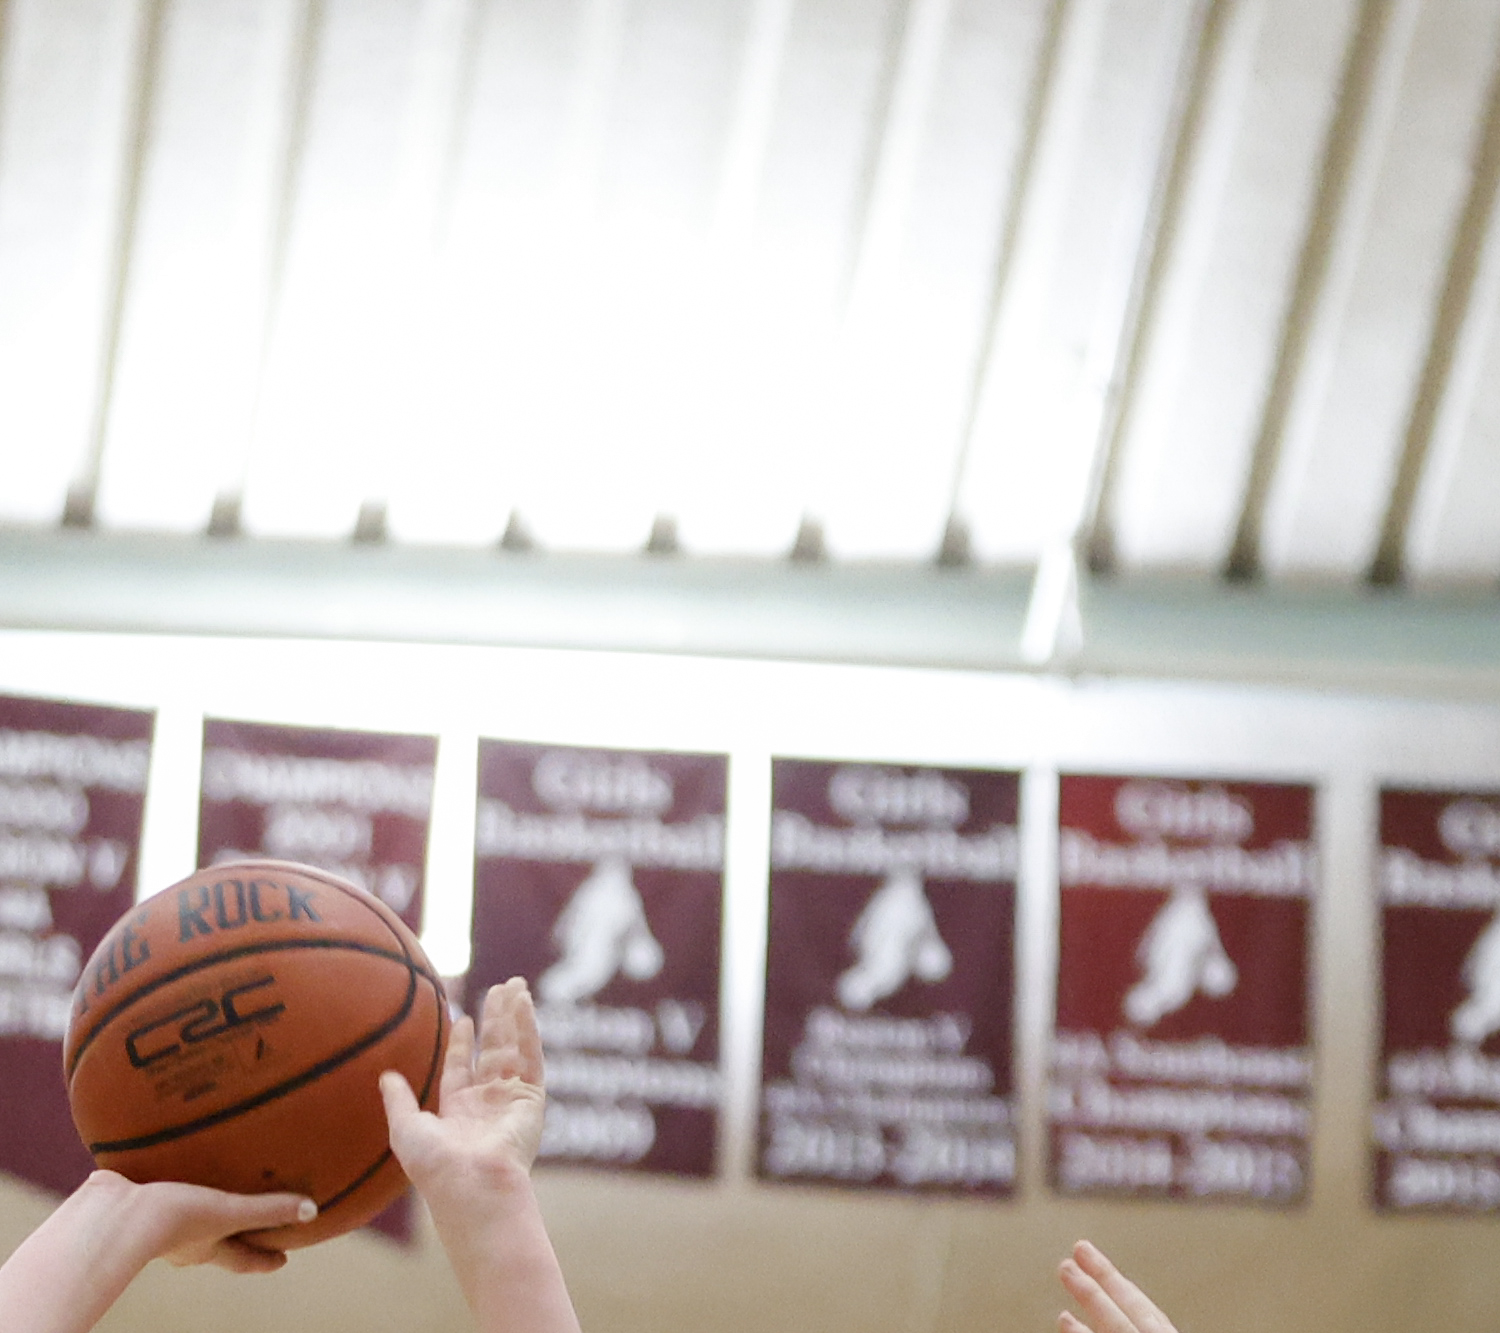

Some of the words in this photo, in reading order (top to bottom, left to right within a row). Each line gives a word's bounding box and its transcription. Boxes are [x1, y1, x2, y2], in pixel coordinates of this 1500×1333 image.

[532, 750, 673, 812] Girls
[828, 763, 970, 828] Girls
[1114, 783, 1256, 845] Girls
[476, 802, 726, 869] Basketball
[772, 810, 1024, 882] Basketball
[1057, 826, 1320, 892] Basketball
[178, 878, 322, 944] ROCK
